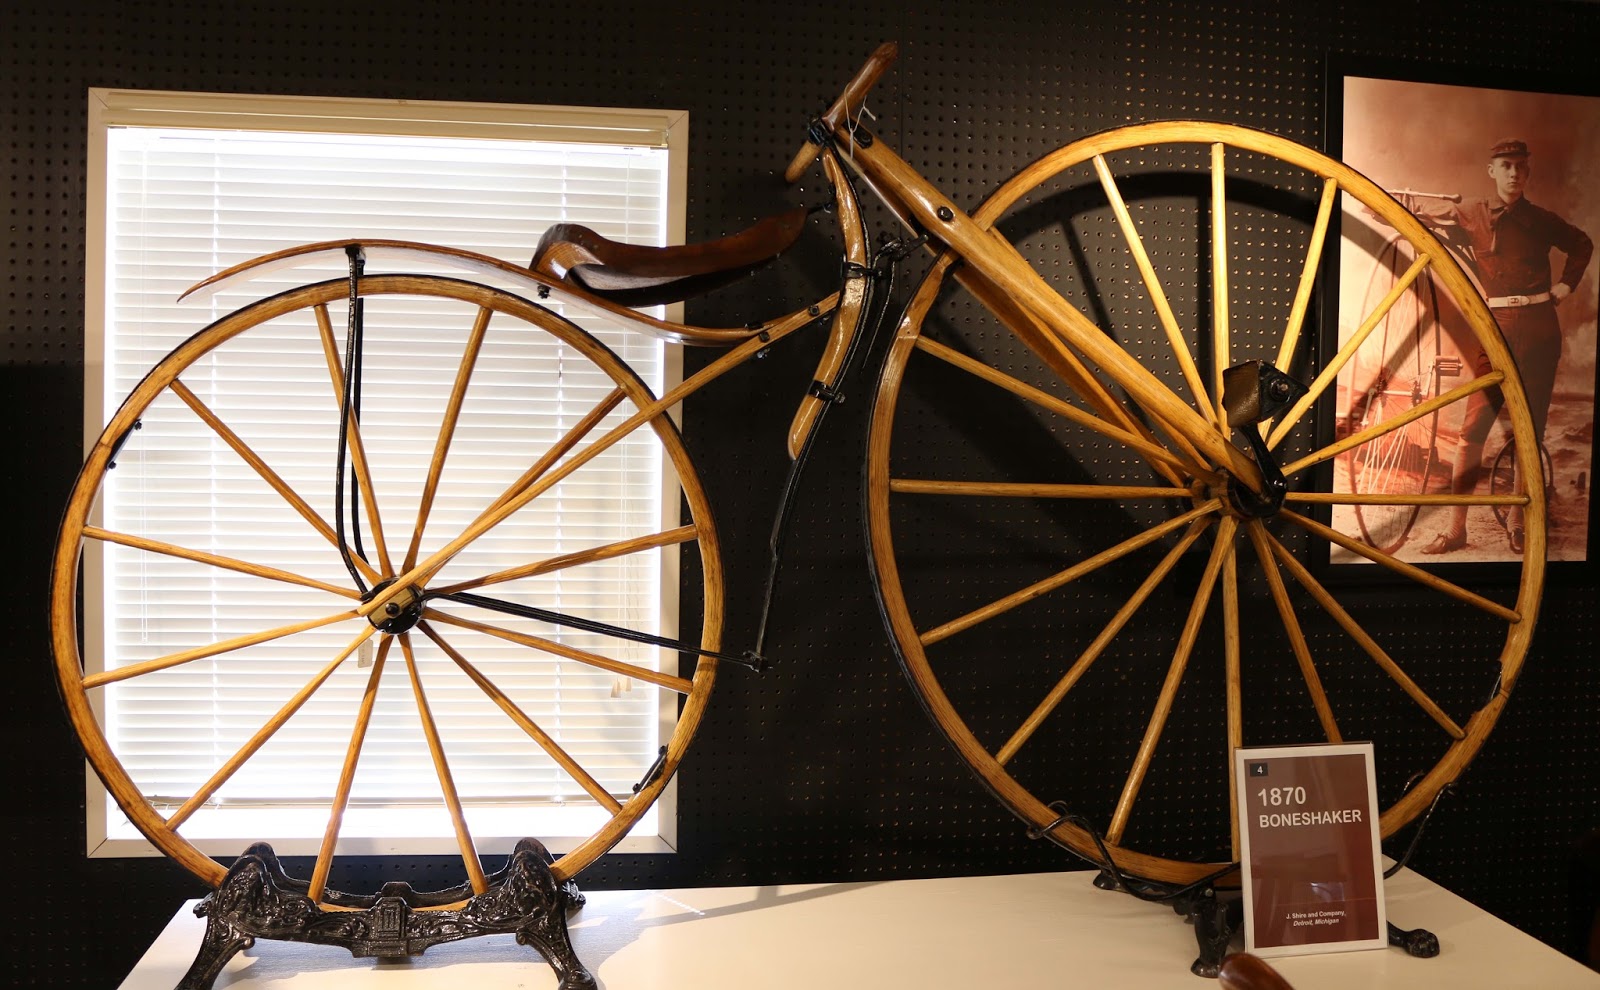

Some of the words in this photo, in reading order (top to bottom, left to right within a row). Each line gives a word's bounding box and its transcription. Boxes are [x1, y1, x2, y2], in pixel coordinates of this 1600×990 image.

[1257, 766, 1263, 774] 4
[1258, 786, 1306, 807] 1870
[1259, 809, 1362, 828] BONESHAKER
